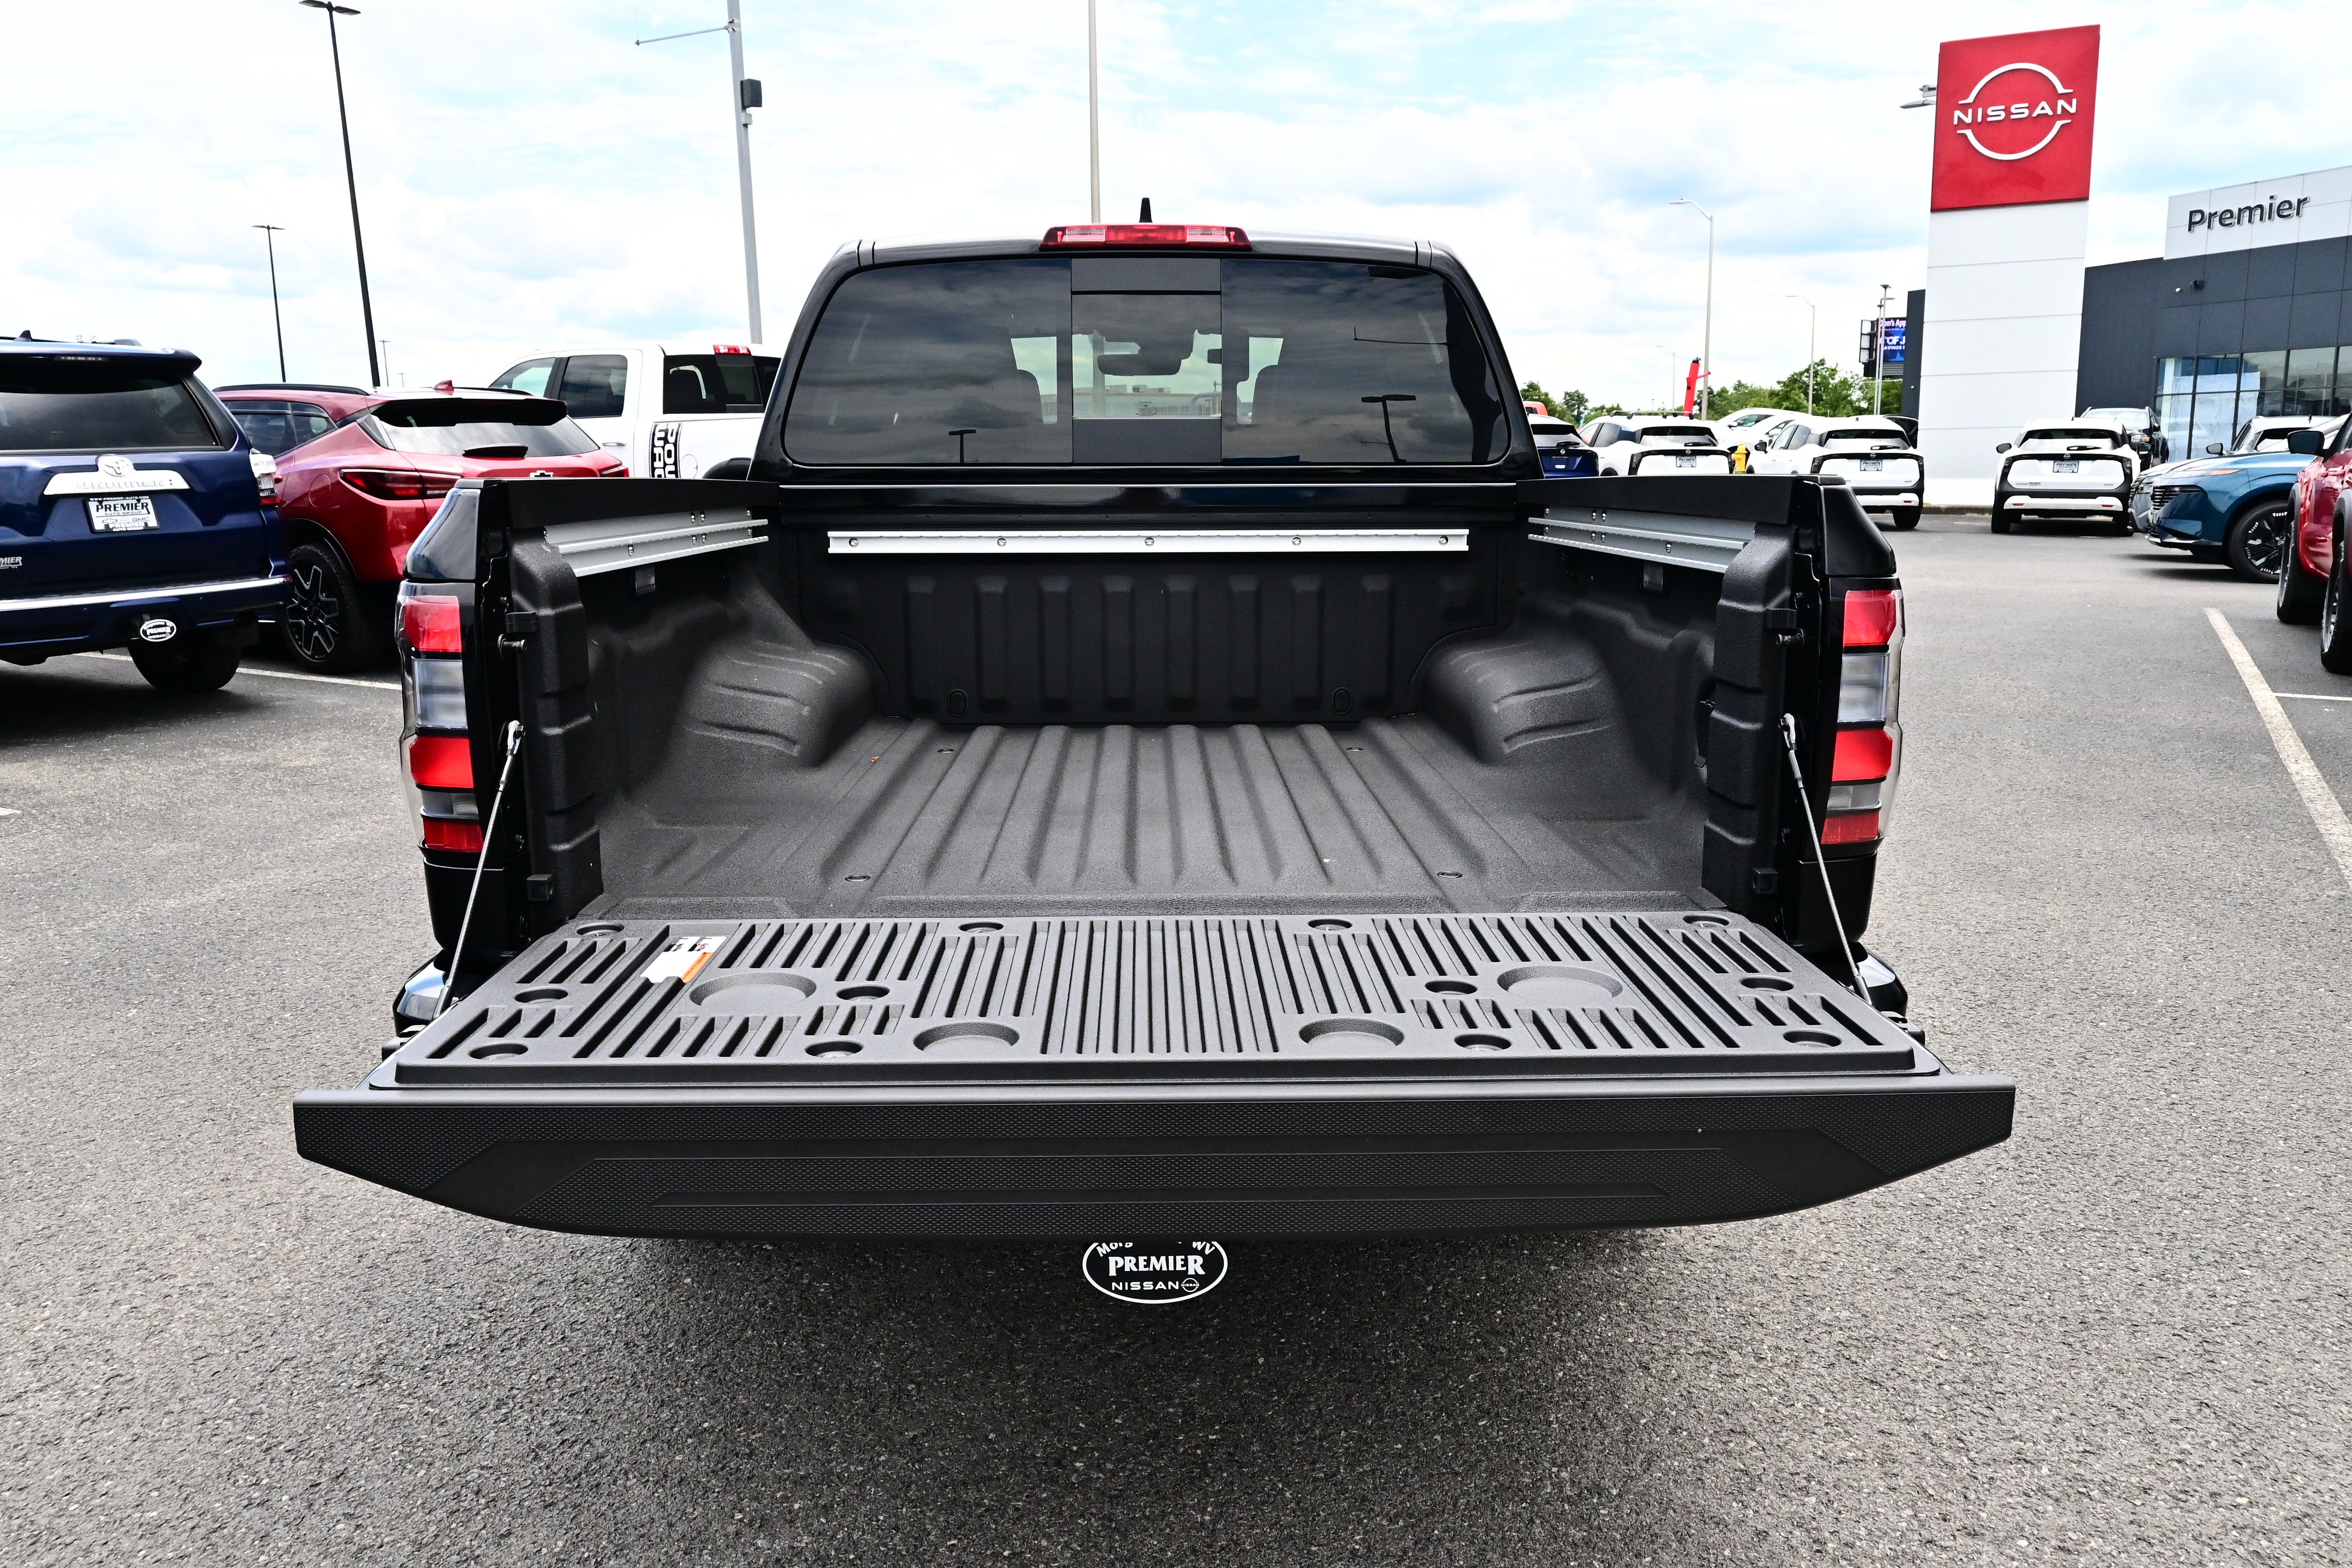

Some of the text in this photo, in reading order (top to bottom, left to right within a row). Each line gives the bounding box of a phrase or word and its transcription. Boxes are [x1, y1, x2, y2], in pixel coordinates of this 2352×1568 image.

[1953, 98, 2077, 125] NISSAN
[2188, 194, 2310, 233] Premier
[1886, 336, 1900, 345] OF
[96, 502, 151, 514] PREMIER
[1192, 1241, 1215, 1255] WV
[1108, 1255, 1206, 1276] PREMIER
[1112, 1281, 1179, 1290] NISSAN
